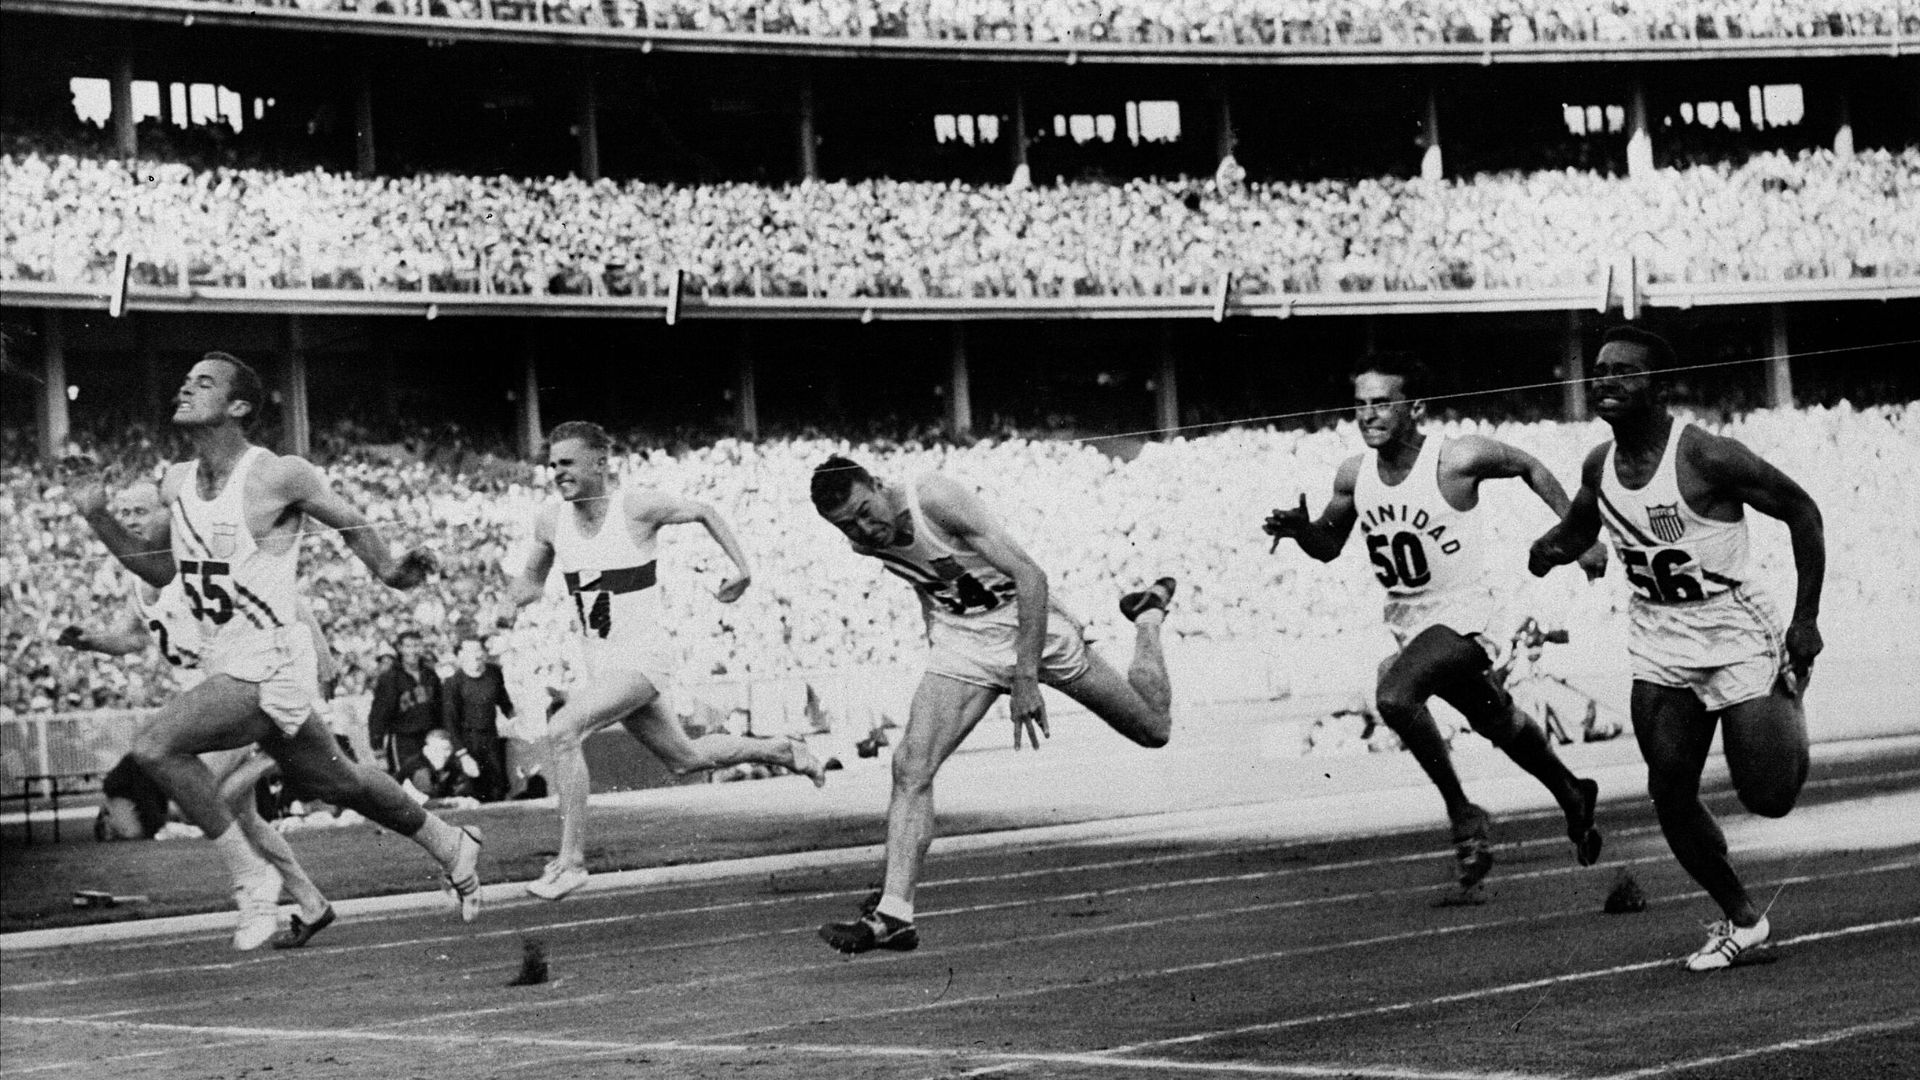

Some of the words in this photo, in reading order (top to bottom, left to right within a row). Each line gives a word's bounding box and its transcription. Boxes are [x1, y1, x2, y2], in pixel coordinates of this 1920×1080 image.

[1366, 531, 1431, 589] 50
[1621, 548, 1704, 604] 56
[180, 560, 233, 625] 55
